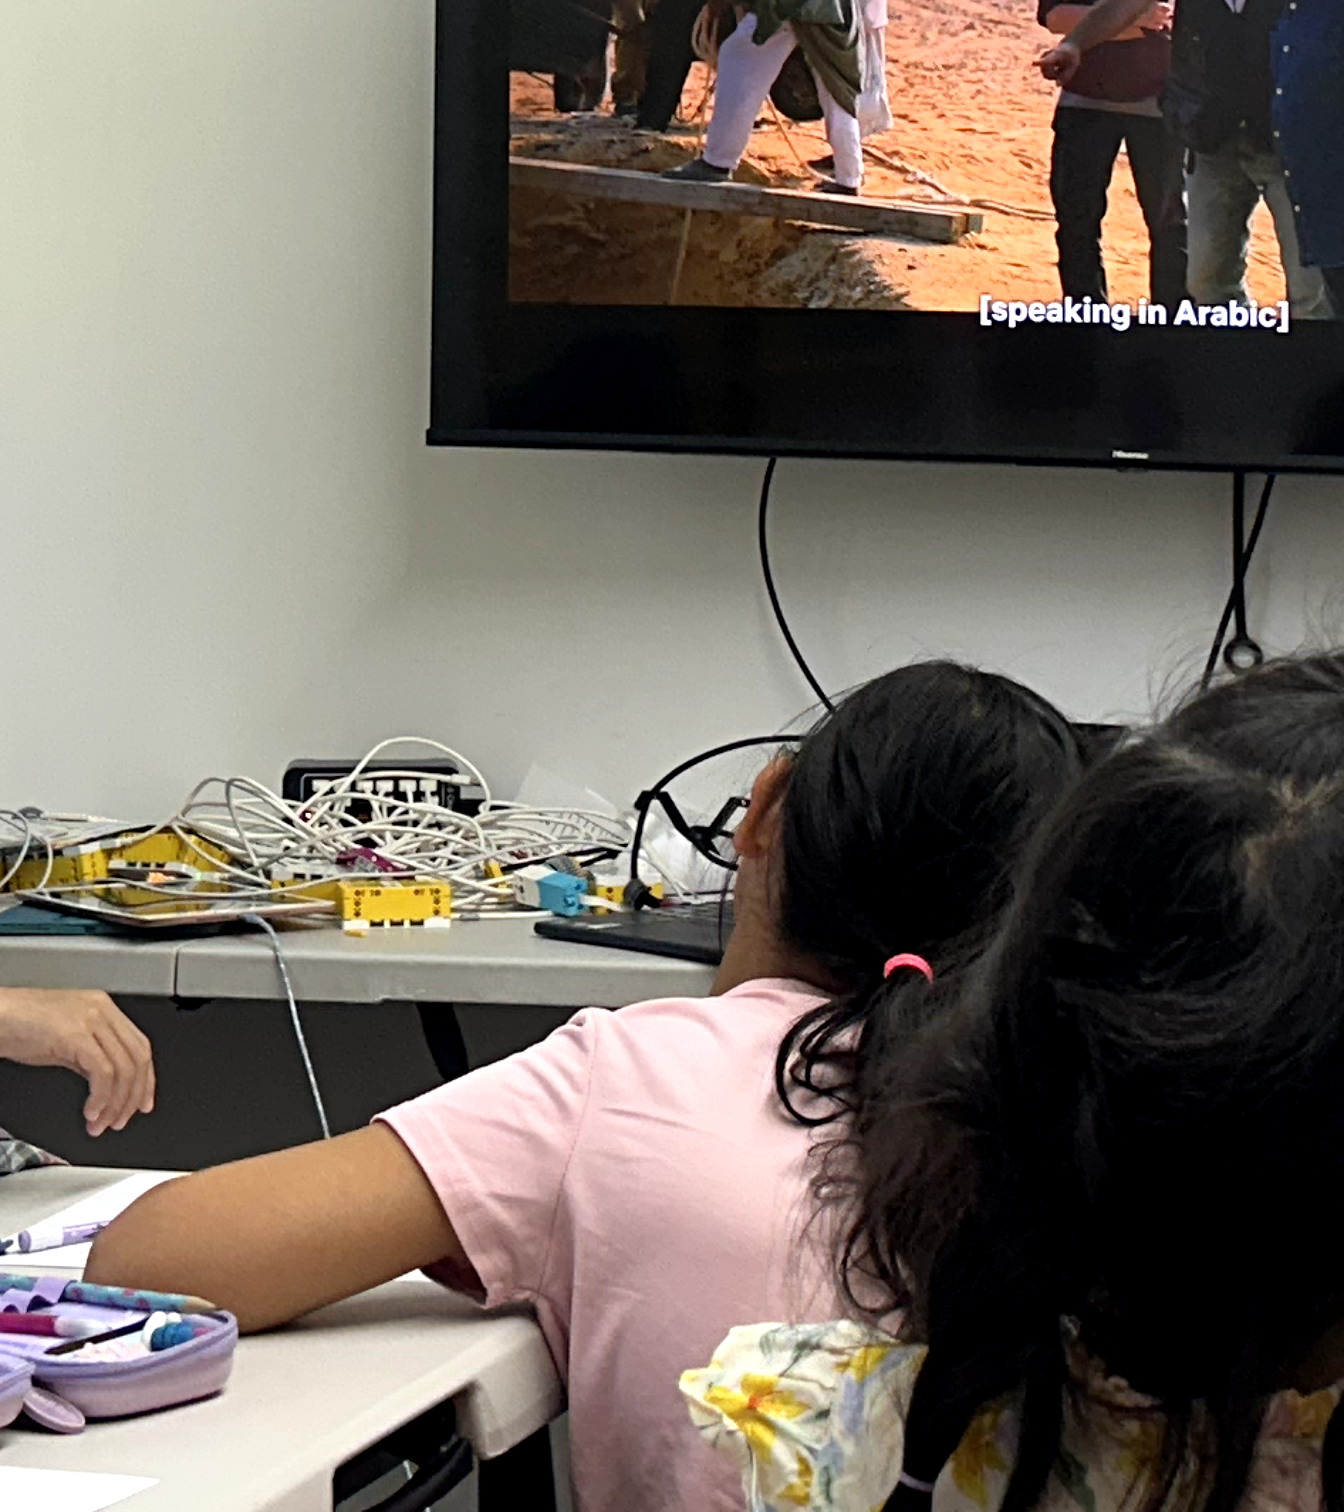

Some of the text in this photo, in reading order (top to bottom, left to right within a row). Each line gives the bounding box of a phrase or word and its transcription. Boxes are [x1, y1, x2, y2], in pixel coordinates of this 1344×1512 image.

[979, 294, 1290, 334] [speaking in Arabic]
